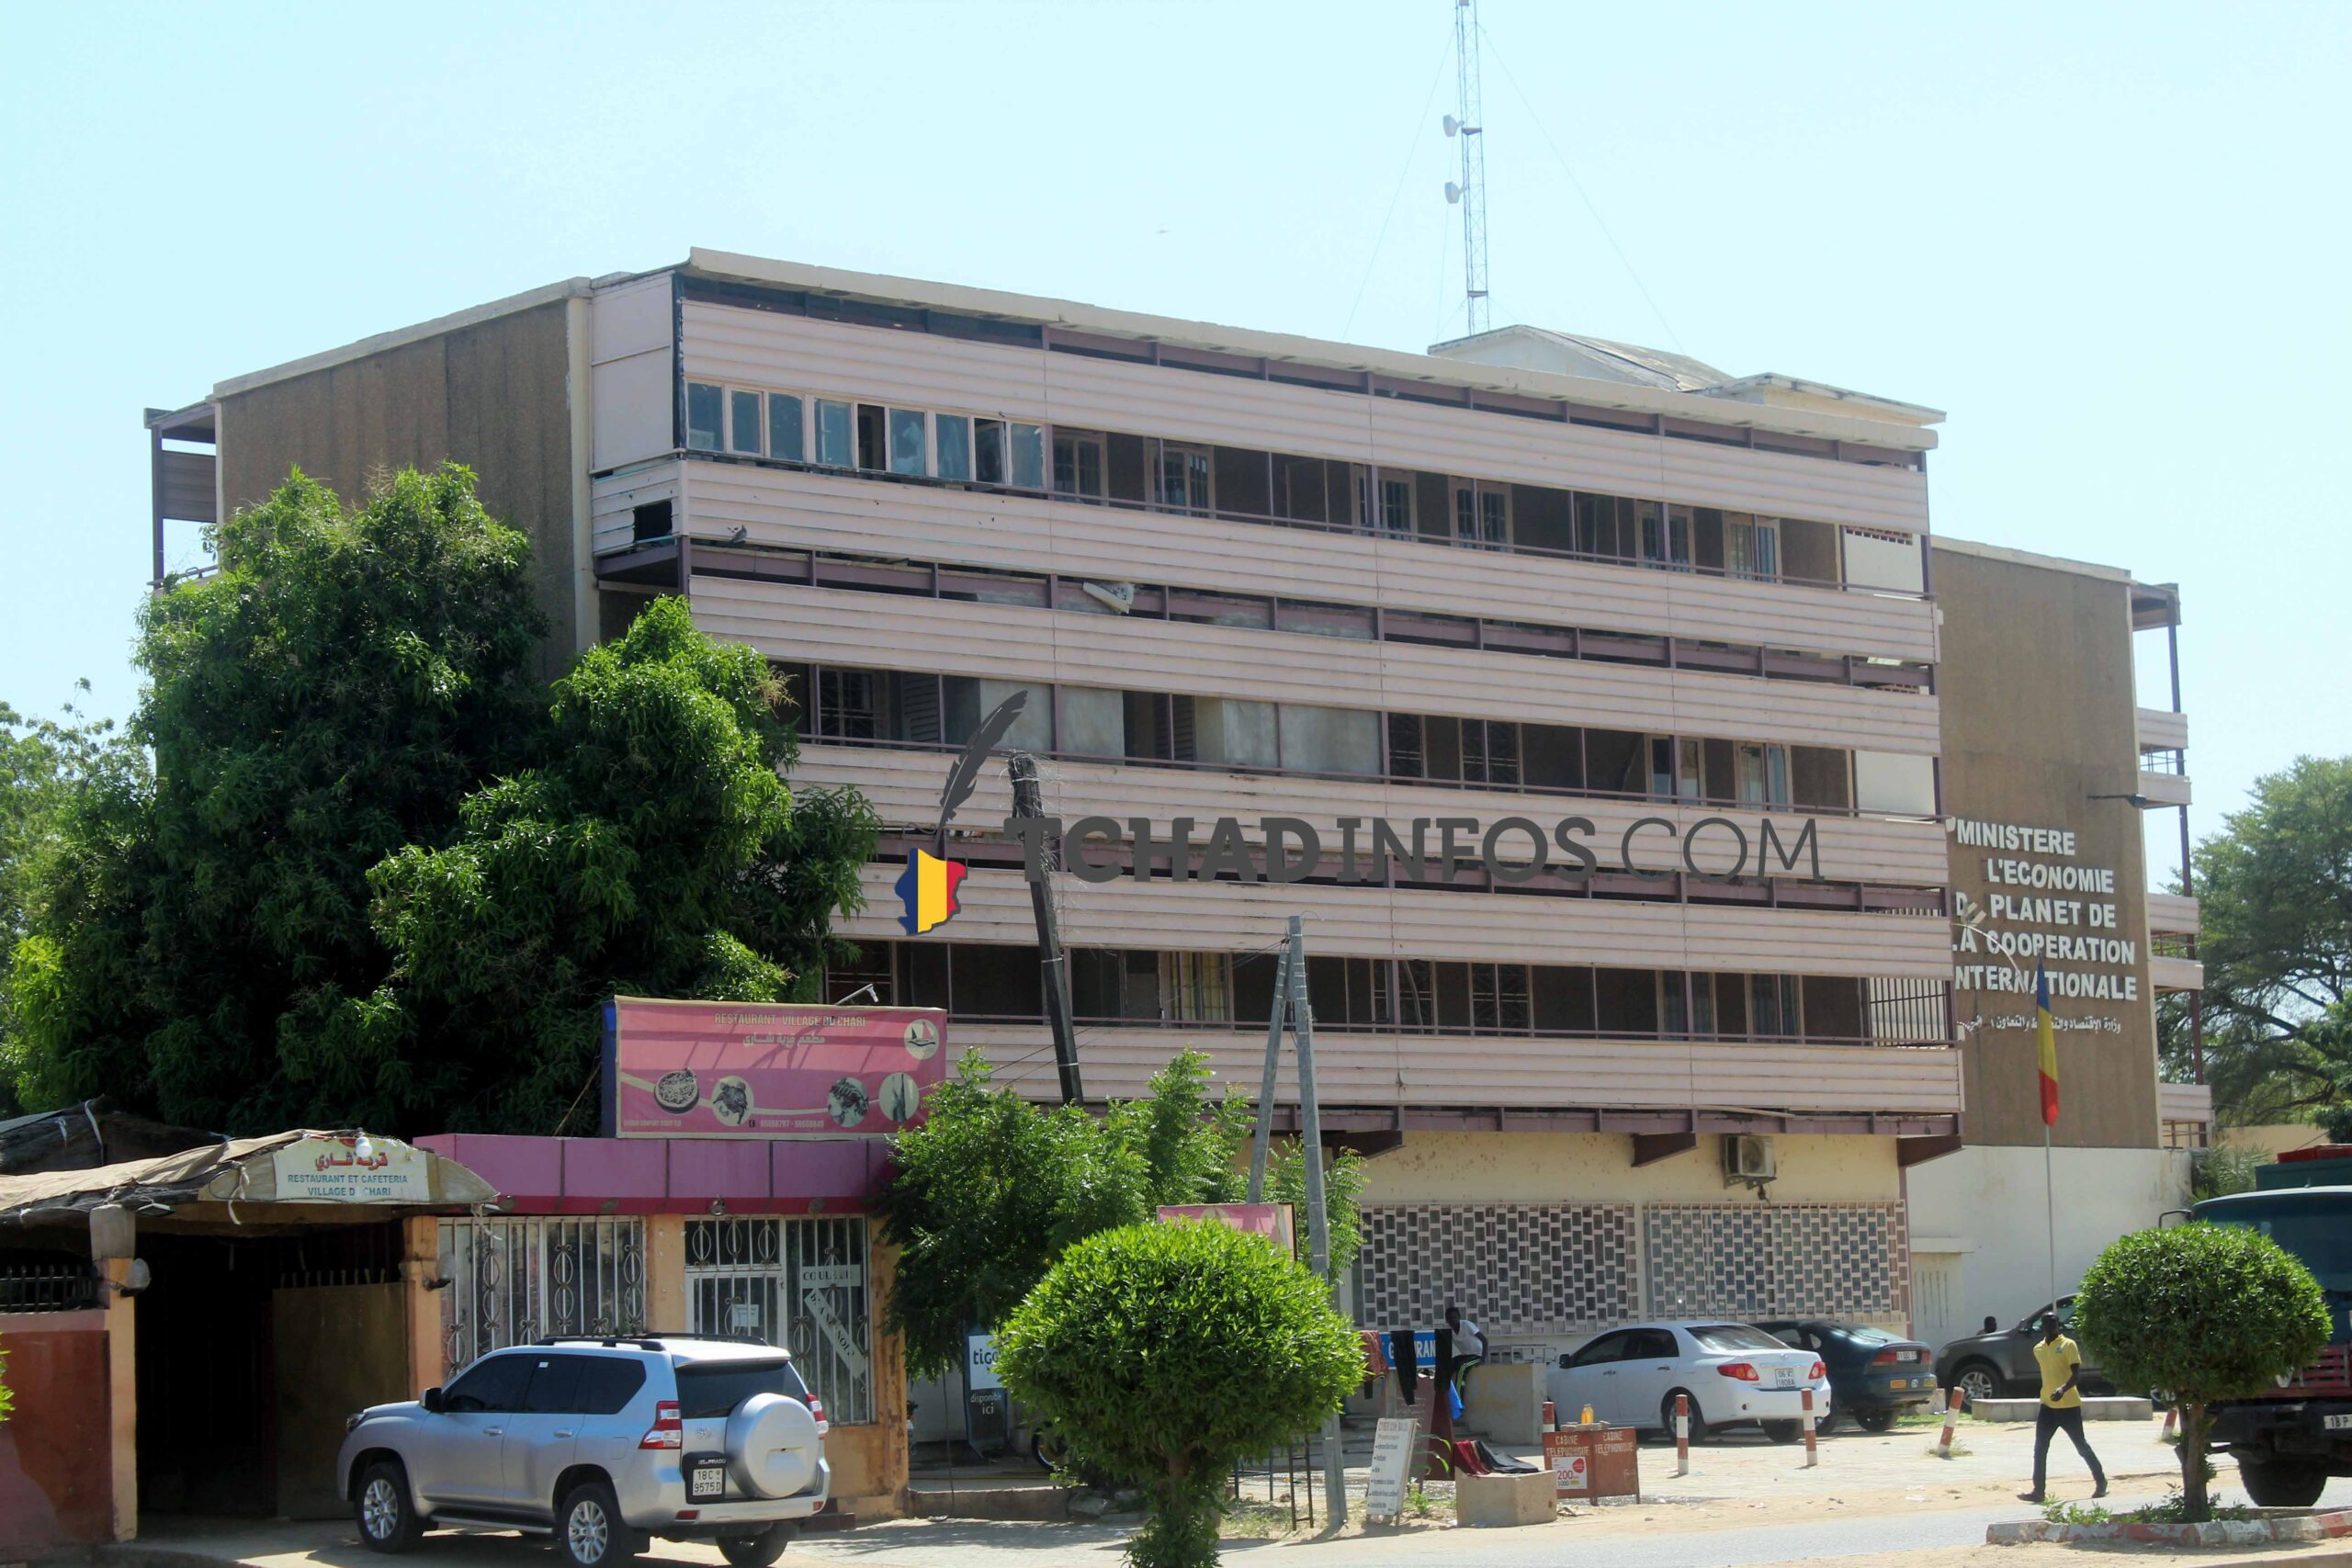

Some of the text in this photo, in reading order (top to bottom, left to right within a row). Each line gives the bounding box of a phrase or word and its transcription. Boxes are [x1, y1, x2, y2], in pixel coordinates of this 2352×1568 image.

[1957, 819, 2075, 855] MINISTERE
[1987, 858, 2114, 893] L'ECONOMIE
[2089, 902, 2116, 928] DE
[1986, 930, 2135, 964] COOPERATION
[715, 1013, 776, 1024] RESTAURANT
[782, 1015, 820, 1026] VILLAGE
[837, 1016, 865, 1027] CHARI
[288, 1175, 408, 1183] RESTAURANT ET CAFETERIA
[308, 1187, 346, 1196] VILLAGE
[981, 1403, 994, 1415] ici
[698, 1471, 714, 1480] 18C
[1557, 1470, 1574, 1480] 200
[695, 1482, 721, 1493] 9575D
